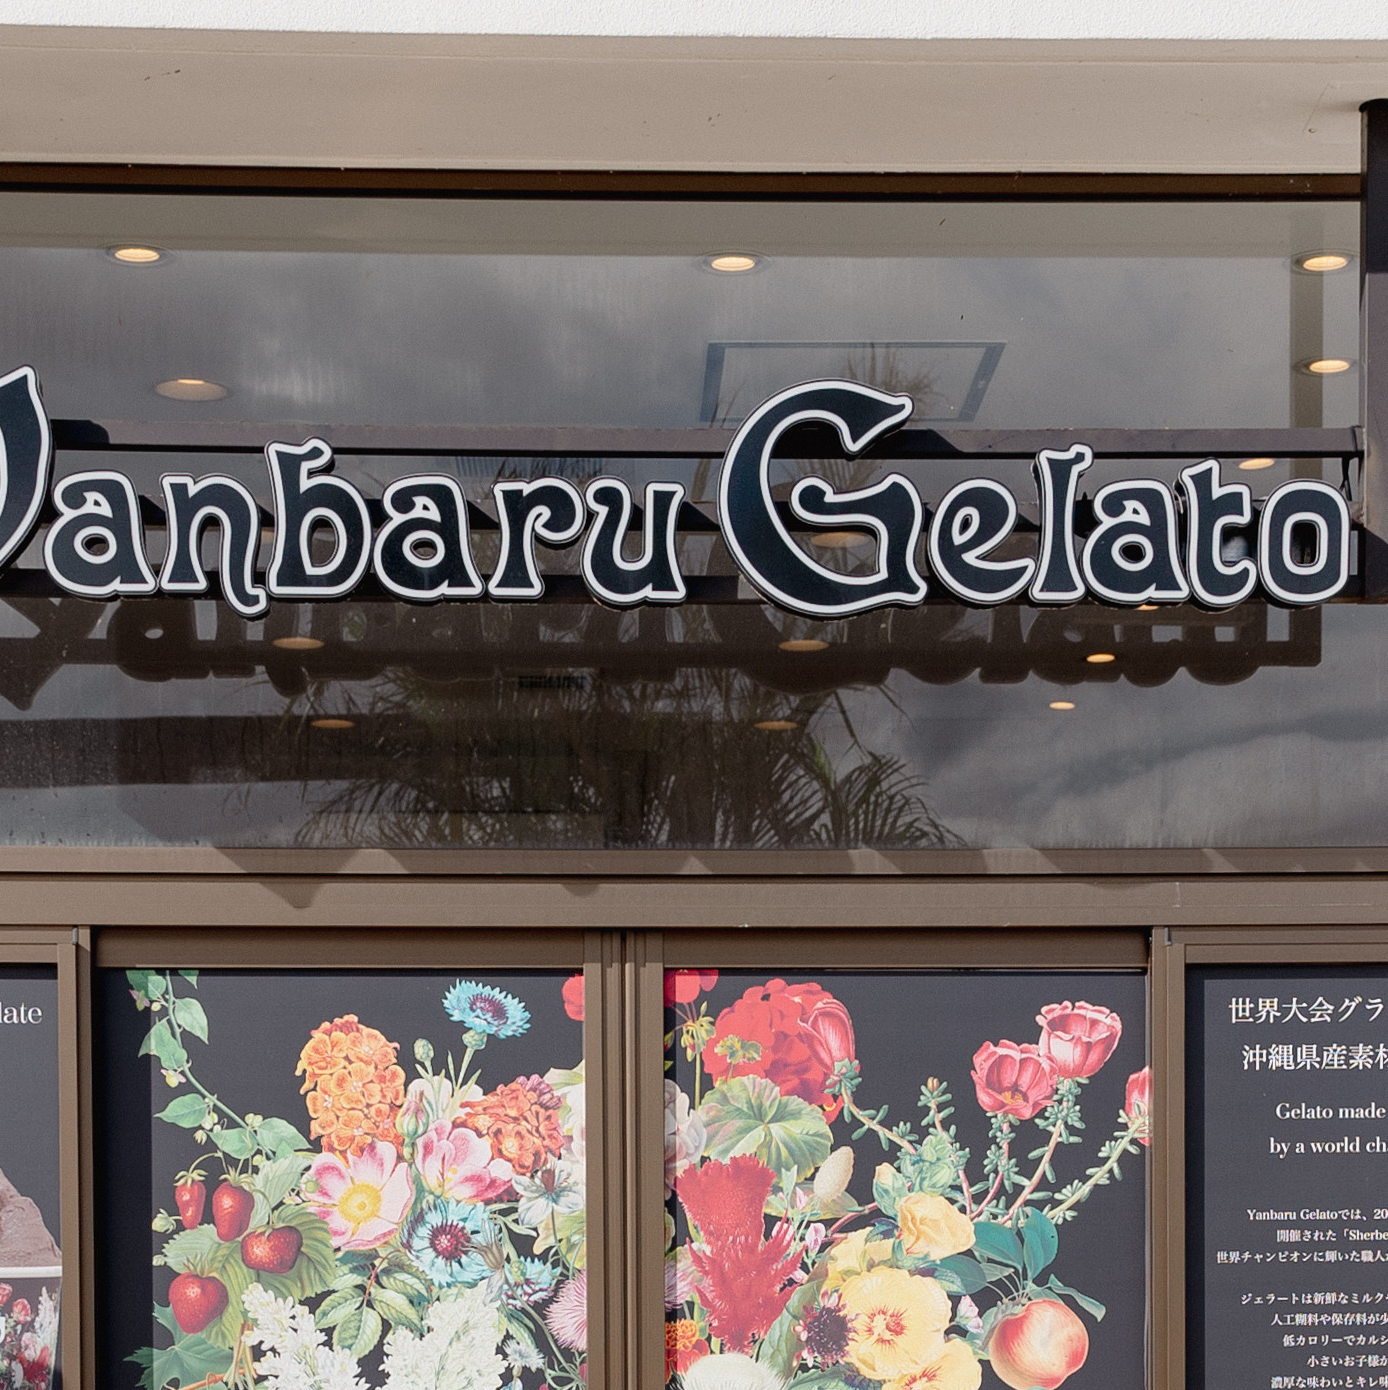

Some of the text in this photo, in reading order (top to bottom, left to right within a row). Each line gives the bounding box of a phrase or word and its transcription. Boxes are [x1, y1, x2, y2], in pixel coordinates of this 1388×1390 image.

[718, 377, 1353, 617] Gelato
[1275, 1102, 1334, 1120] Gelato
[1338, 1102, 1387, 1119] made
[1269, 1137, 1291, 1159] by
[1295, 1141, 1305, 1154] a
[1310, 1137, 1360, 1154] world
[1247, 1209, 1296, 1221] Yanbaru
